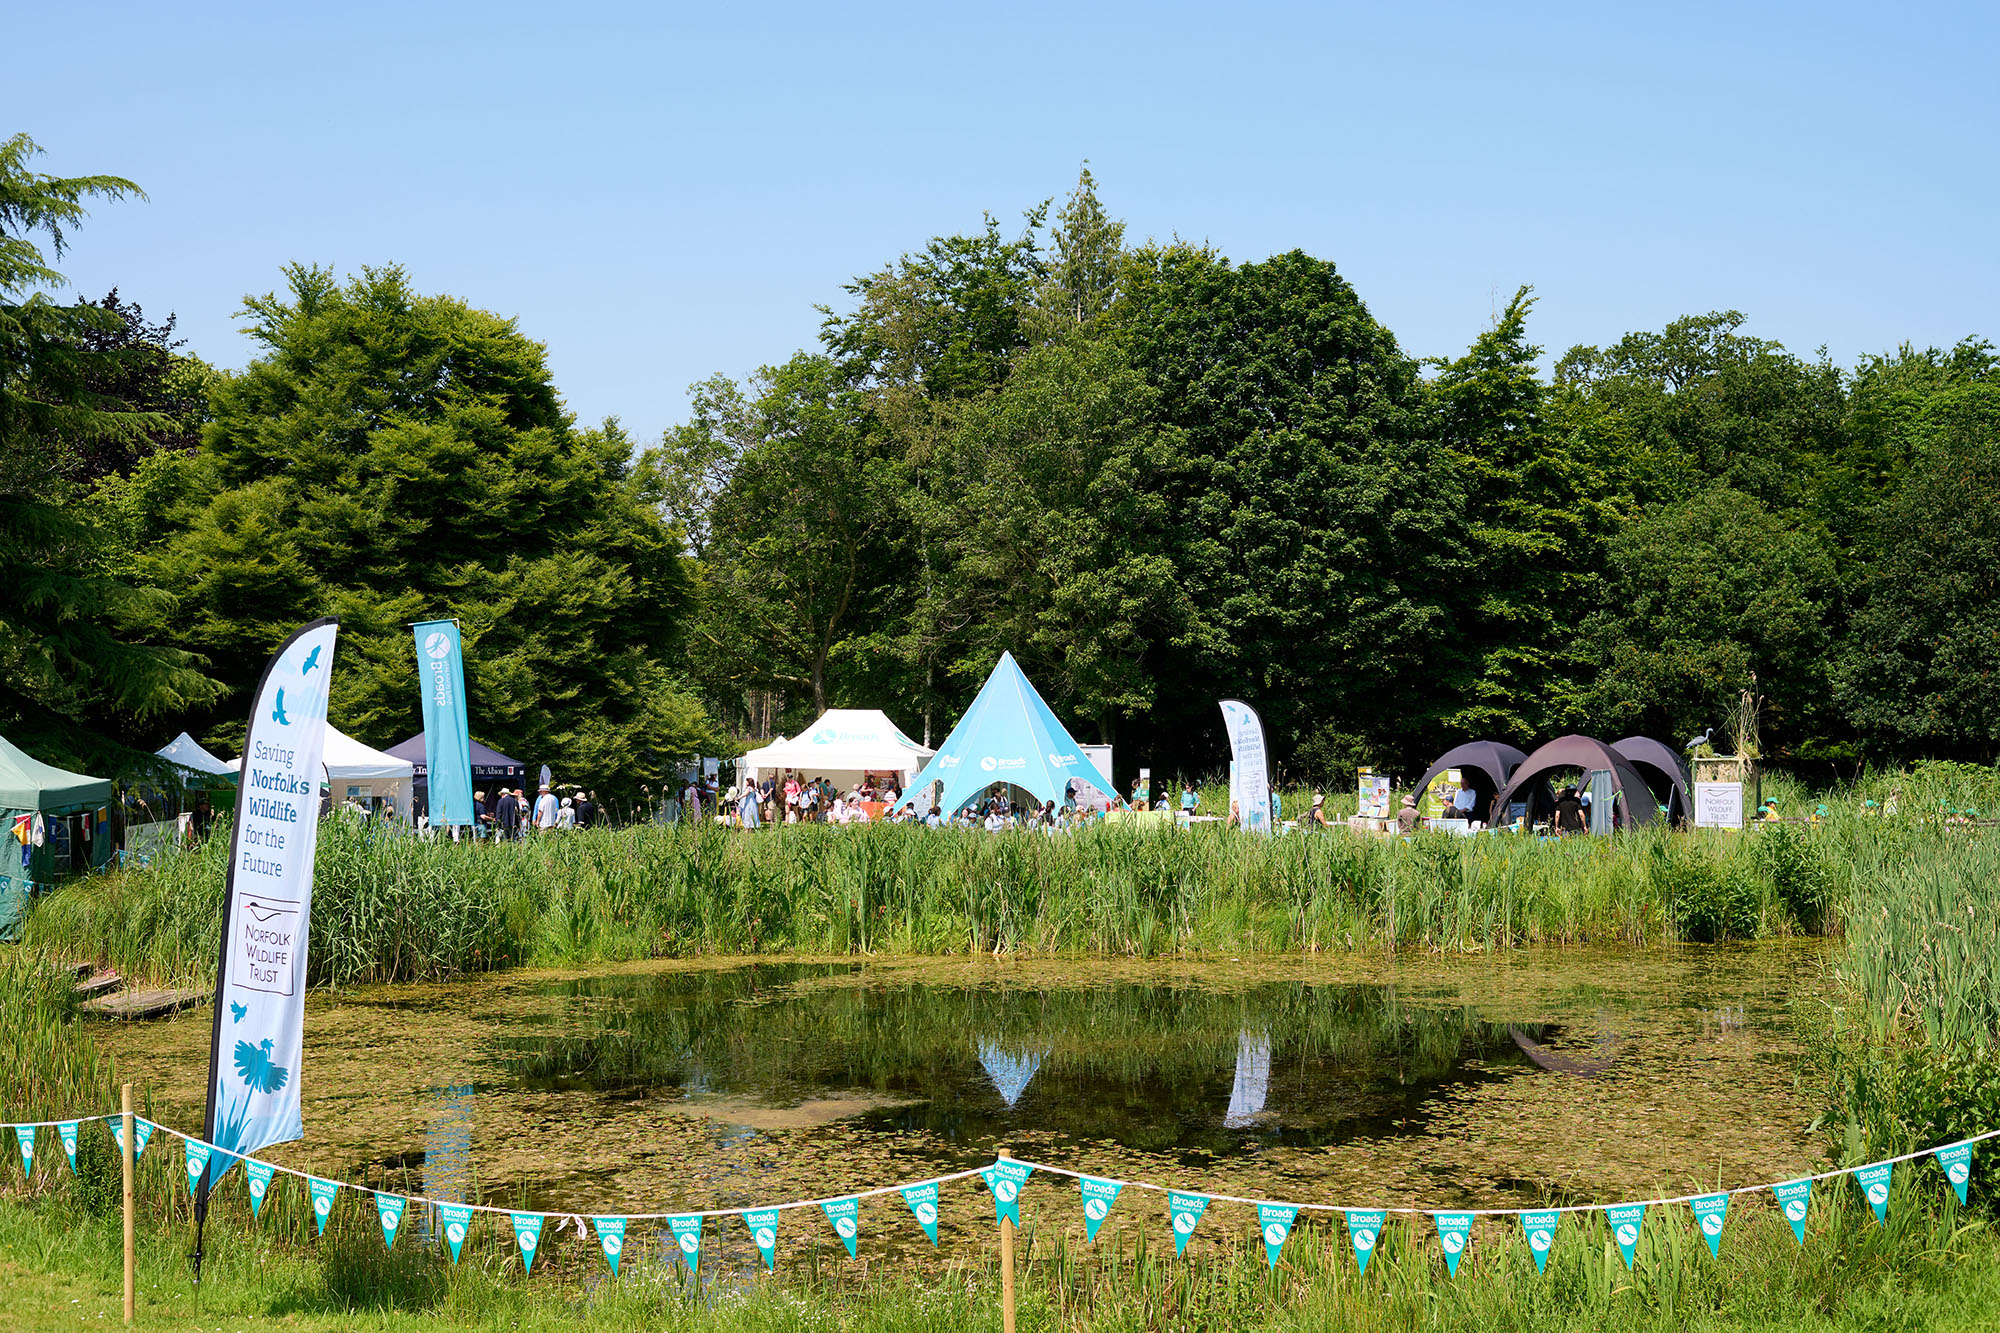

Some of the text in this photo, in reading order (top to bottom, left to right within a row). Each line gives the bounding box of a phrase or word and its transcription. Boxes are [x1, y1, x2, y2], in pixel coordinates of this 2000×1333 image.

[254, 741, 294, 768] Saving
[475, 766, 504, 775] The Albion
[251, 769, 310, 795] Norfolk's
[249, 797, 297, 823] Wildlife
[245, 824, 285, 850] for the
[242, 852, 282, 877] Future
[245, 924, 290, 946] NORFOLK
[247, 943, 287, 965] WILDLIFE
[250, 963, 278, 983] TRUST
[187, 1142, 209, 1156] Broads
[1940, 1146, 1969, 1160] Broads
[248, 1163, 271, 1176] Broads
[1860, 1166, 1888, 1180] Broads
[312, 1181, 334, 1193] Broads
[906, 1186, 935, 1199] Broads
[1084, 1181, 1116, 1195] Broads
[1778, 1184, 1807, 1197] Broads
[378, 1196, 402, 1206] Broads
[826, 1201, 854, 1213] Broads
[1173, 1195, 1204, 1208] Broads
[1696, 1197, 1725, 1210] Broads
[444, 1208, 469, 1218] Broads
[747, 1212, 775, 1222] Broads
[1262, 1207, 1293, 1218] Broads
[1351, 1214, 1381, 1223] Broads
[1525, 1214, 1555, 1224] Broads
[1611, 1208, 1640, 1219] Broads
[514, 1216, 540, 1225] Broads
[597, 1220, 623, 1228] Broads
[672, 1218, 699, 1227] Broads
[1439, 1216, 1469, 1225] Broads
